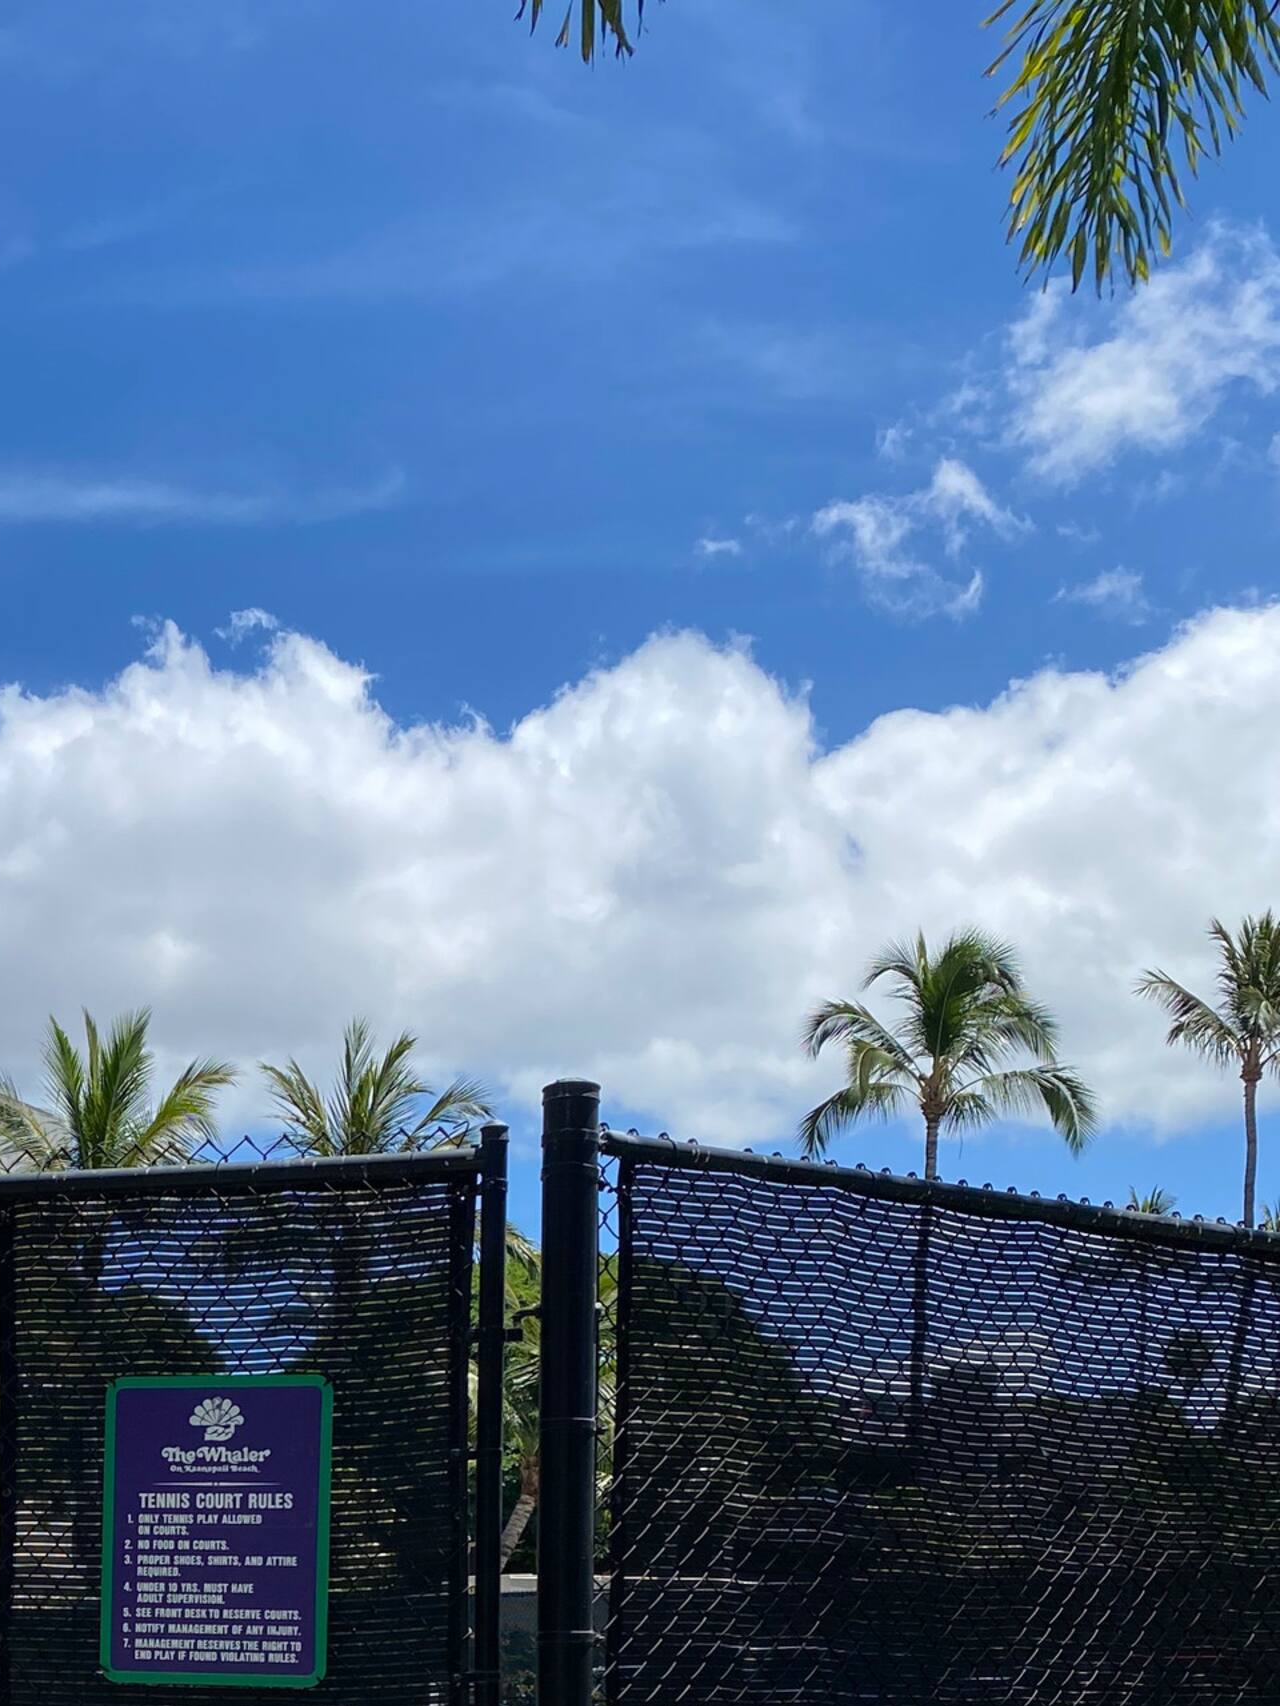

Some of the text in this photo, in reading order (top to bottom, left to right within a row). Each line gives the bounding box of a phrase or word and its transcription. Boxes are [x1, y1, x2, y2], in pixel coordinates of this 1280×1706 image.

[162, 1447, 270, 1463] The Whaler
[231, 1465, 260, 1473] Beach
[139, 1493, 293, 1509] TENNIS COURT RULES
[128, 1515, 262, 1524] 1. ONLY TENNIS PLAY ALLOWED
[138, 1526, 189, 1535] ON COURTS.
[125, 1540, 229, 1550] 2. NO FOOD ON COURTS.
[124, 1555, 297, 1566] 3. PROPER SHOES, SHIRTS, AND ATTIRE
[137, 1567, 181, 1578] REQUIRED.
[124, 1582, 254, 1593] 4. UNDER 10 YRS. MUST HAVE
[137, 1594, 225, 1604] ADULT SUPERVISION.
[123, 1608, 301, 1620] 5. SEE FRONT DESK TO RESERVE COURTS.
[123, 1623, 301, 1636] 6. NOTIFY MANAGEMENT OF ANY INJURY.
[123, 1639, 301, 1651] 7. MANAGEMENT RESERVES THE RIGHT TO
[135, 1651, 299, 1663] END PLAY IF FOUND VIOLATING RULES.
